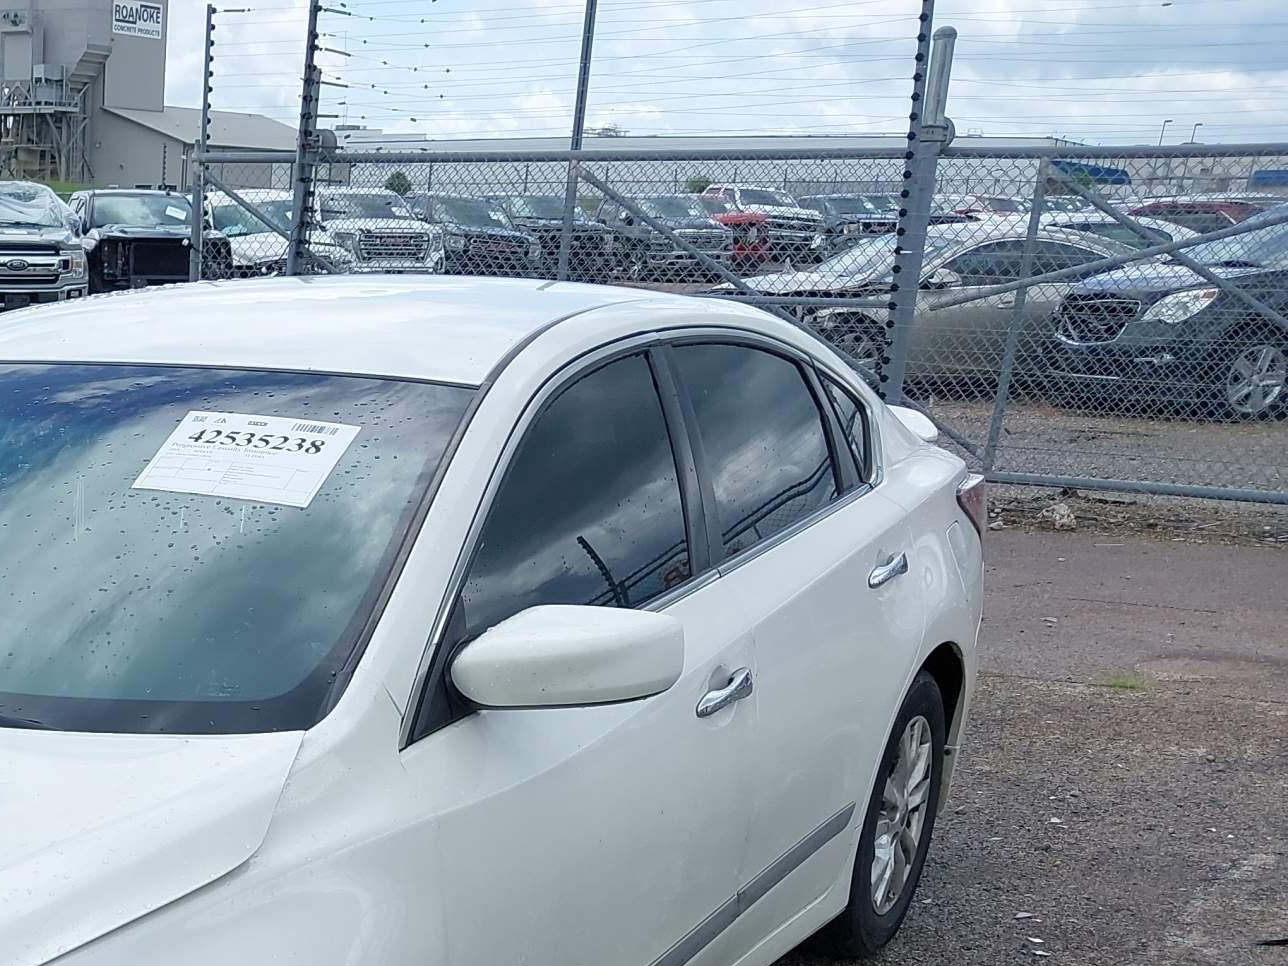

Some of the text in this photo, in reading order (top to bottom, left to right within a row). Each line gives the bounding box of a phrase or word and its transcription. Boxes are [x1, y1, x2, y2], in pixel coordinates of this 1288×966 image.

[115, 4, 161, 24] ROANOKE
[114, 24, 137, 33] CONCRETE
[188, 428, 325, 455] 42535238
